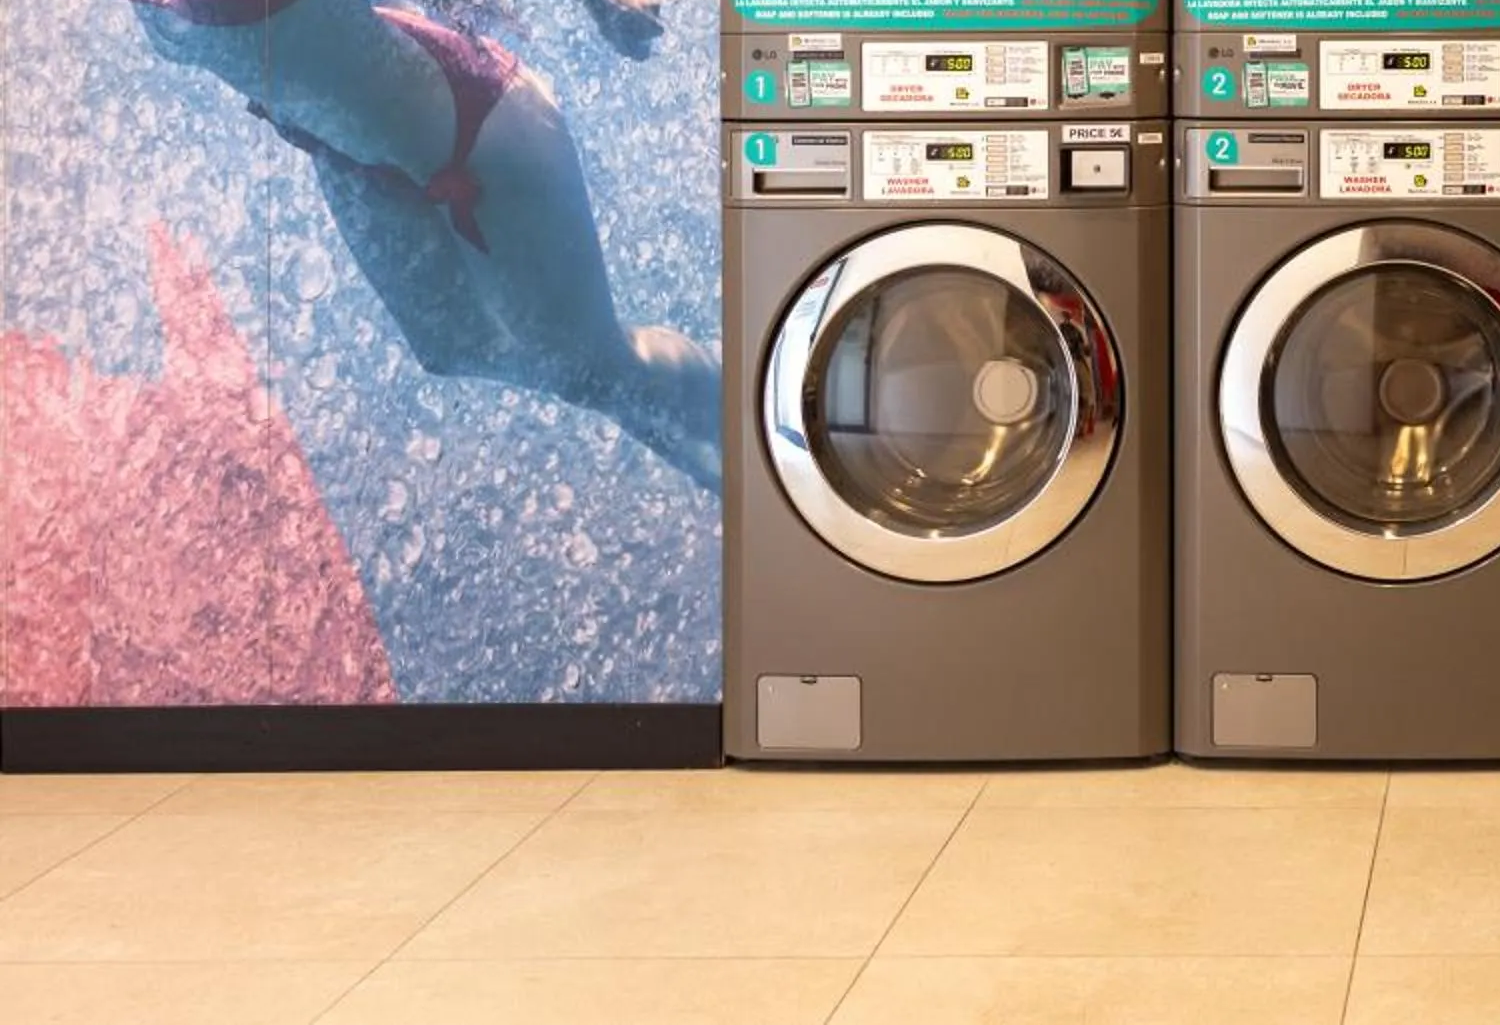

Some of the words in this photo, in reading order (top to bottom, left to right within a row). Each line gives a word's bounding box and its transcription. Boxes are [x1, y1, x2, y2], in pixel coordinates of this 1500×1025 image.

[755, 76, 765, 99] 1
[1211, 72, 1227, 95] 2
[1069, 128, 1106, 139] PRICE
[755, 138, 764, 160] 1
[1215, 138, 1229, 159] 2
[1344, 176, 1387, 184] WASHER
